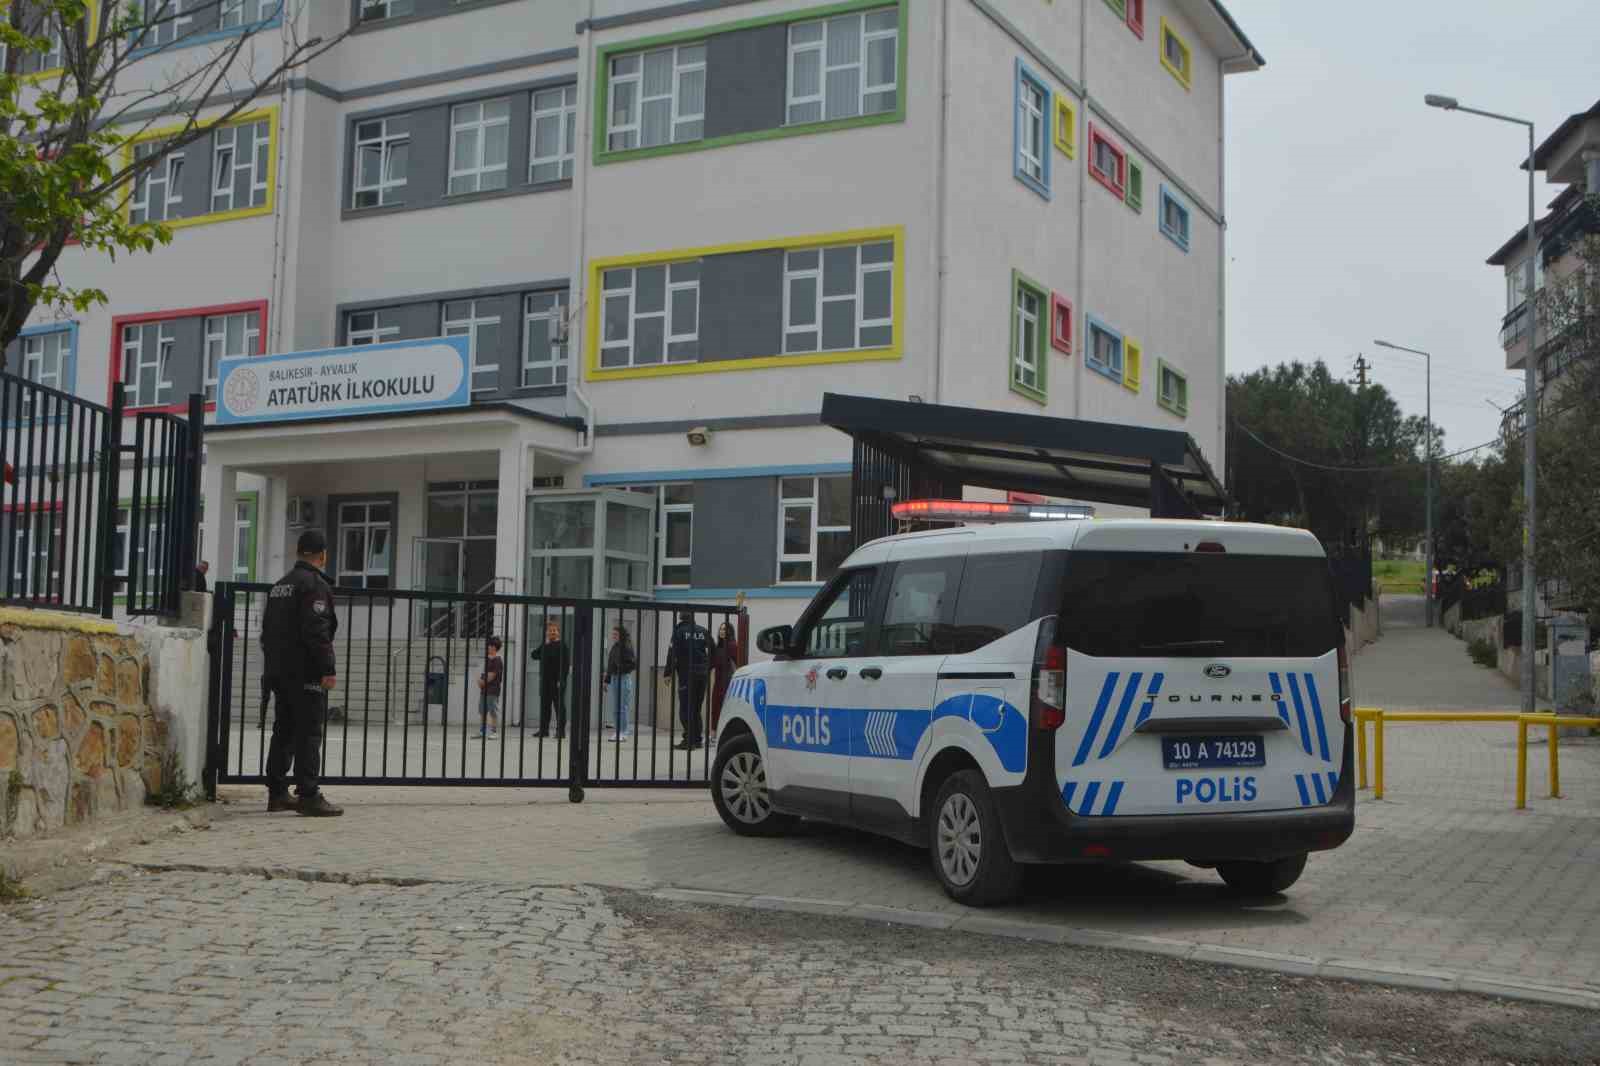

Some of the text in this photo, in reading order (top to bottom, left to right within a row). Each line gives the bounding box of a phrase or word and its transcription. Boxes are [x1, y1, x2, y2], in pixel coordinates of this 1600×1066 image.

[320, 362, 358, 376] AYVALIK
[267, 375, 435, 406] ATATÜRK İLKOKULU
[1147, 694, 1281, 702] TOURNEO
[1174, 741, 1256, 759] 10 A 74129
